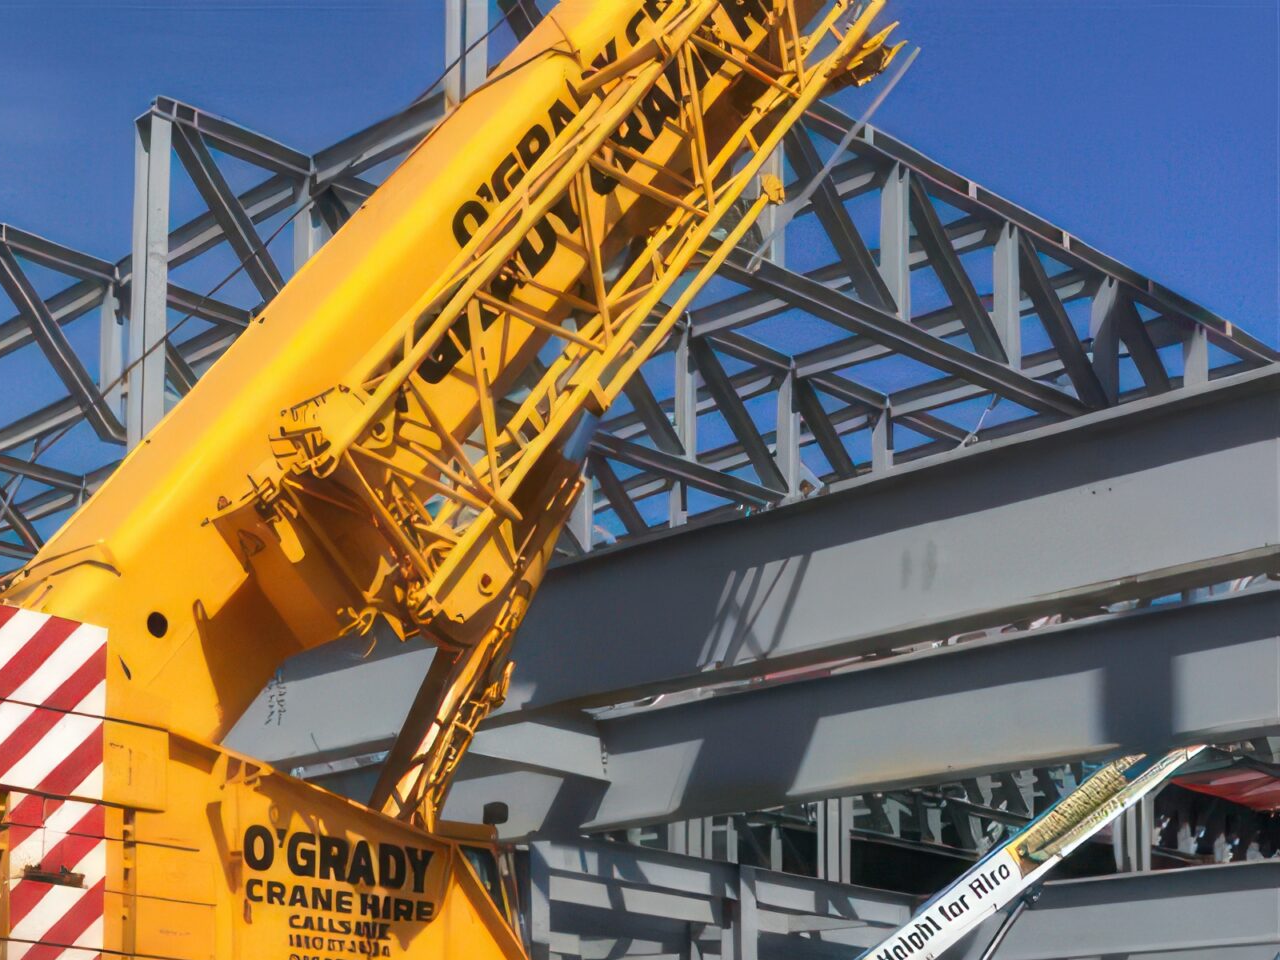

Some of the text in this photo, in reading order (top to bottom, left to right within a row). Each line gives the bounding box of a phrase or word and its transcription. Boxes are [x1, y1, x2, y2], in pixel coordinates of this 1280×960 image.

[243, 825, 434, 893] O'GRADY
[246, 878, 435, 922] CRANE HIRE
